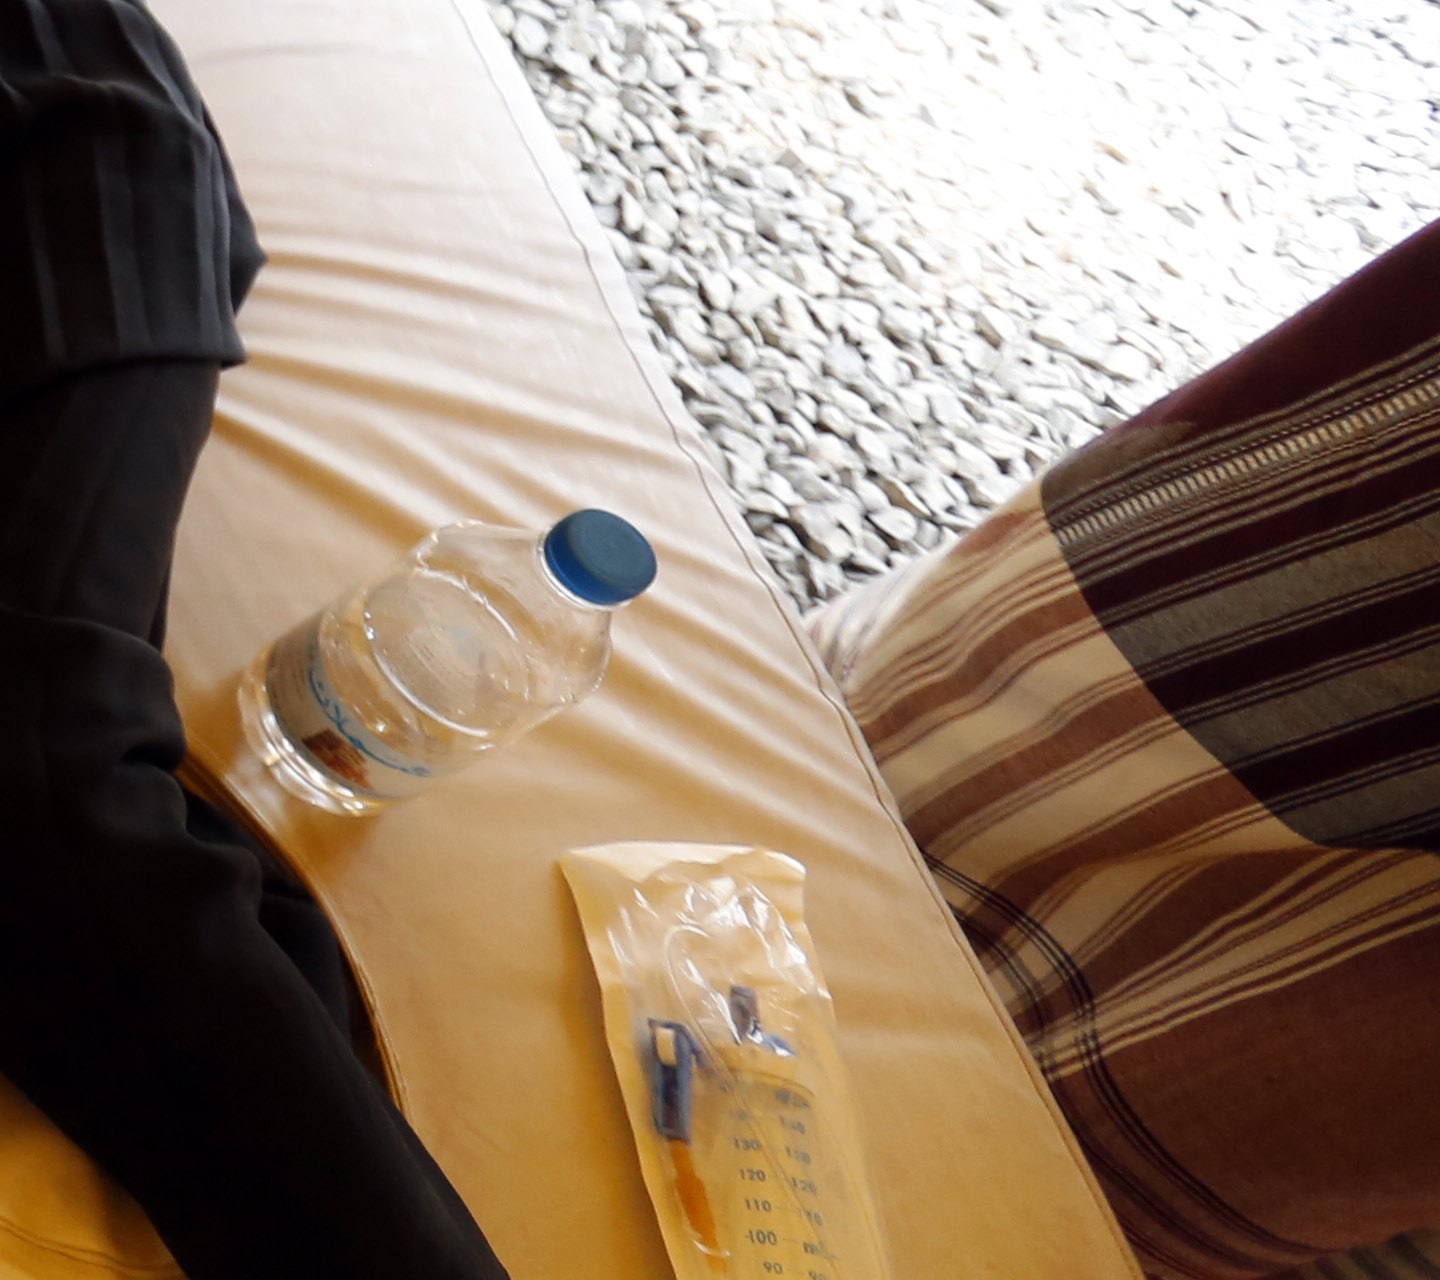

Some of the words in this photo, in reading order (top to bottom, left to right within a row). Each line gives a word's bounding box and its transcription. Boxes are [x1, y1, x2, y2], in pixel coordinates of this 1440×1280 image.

[734, 1137, 763, 1151] 130
[739, 1168, 766, 1182] 120
[744, 1198, 772, 1212] 110
[747, 1228, 777, 1246] 100
[763, 1261, 784, 1275] 90
